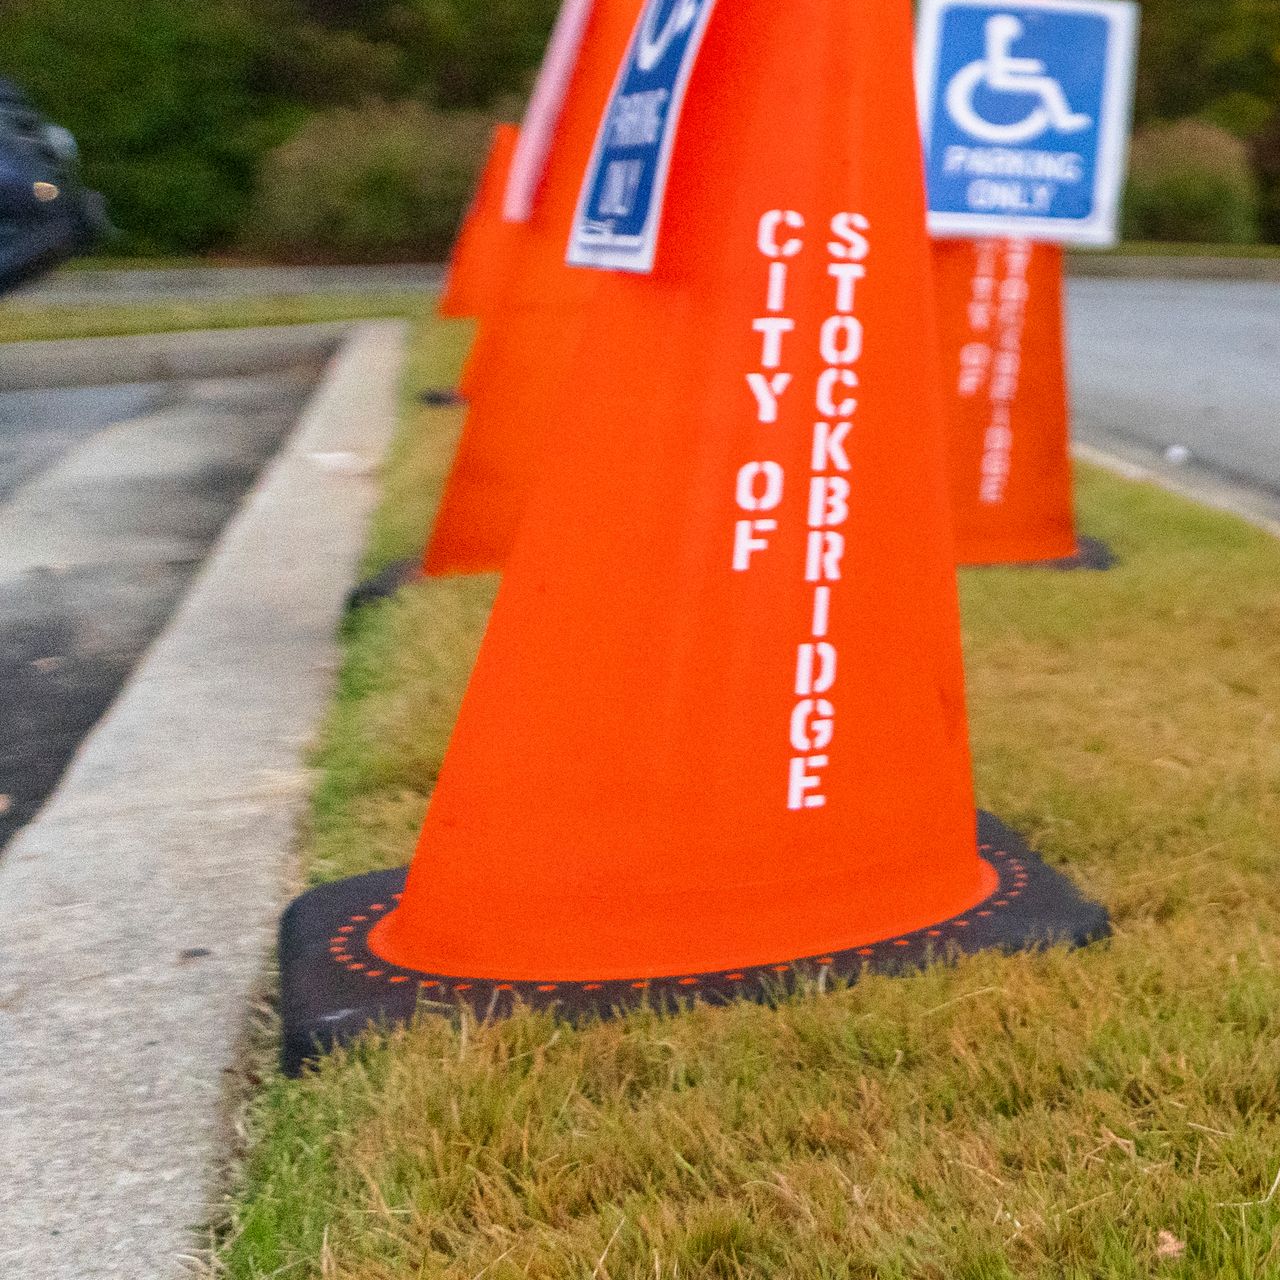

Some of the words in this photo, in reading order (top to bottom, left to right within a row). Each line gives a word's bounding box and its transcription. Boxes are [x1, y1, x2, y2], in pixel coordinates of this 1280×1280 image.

[943, 145, 1083, 182] PARKING
[966, 179, 1055, 211] ONLY
[745, 210, 805, 423] CITY
[732, 460, 784, 571] OF
[787, 212, 870, 811] STOCKBRIDGE
